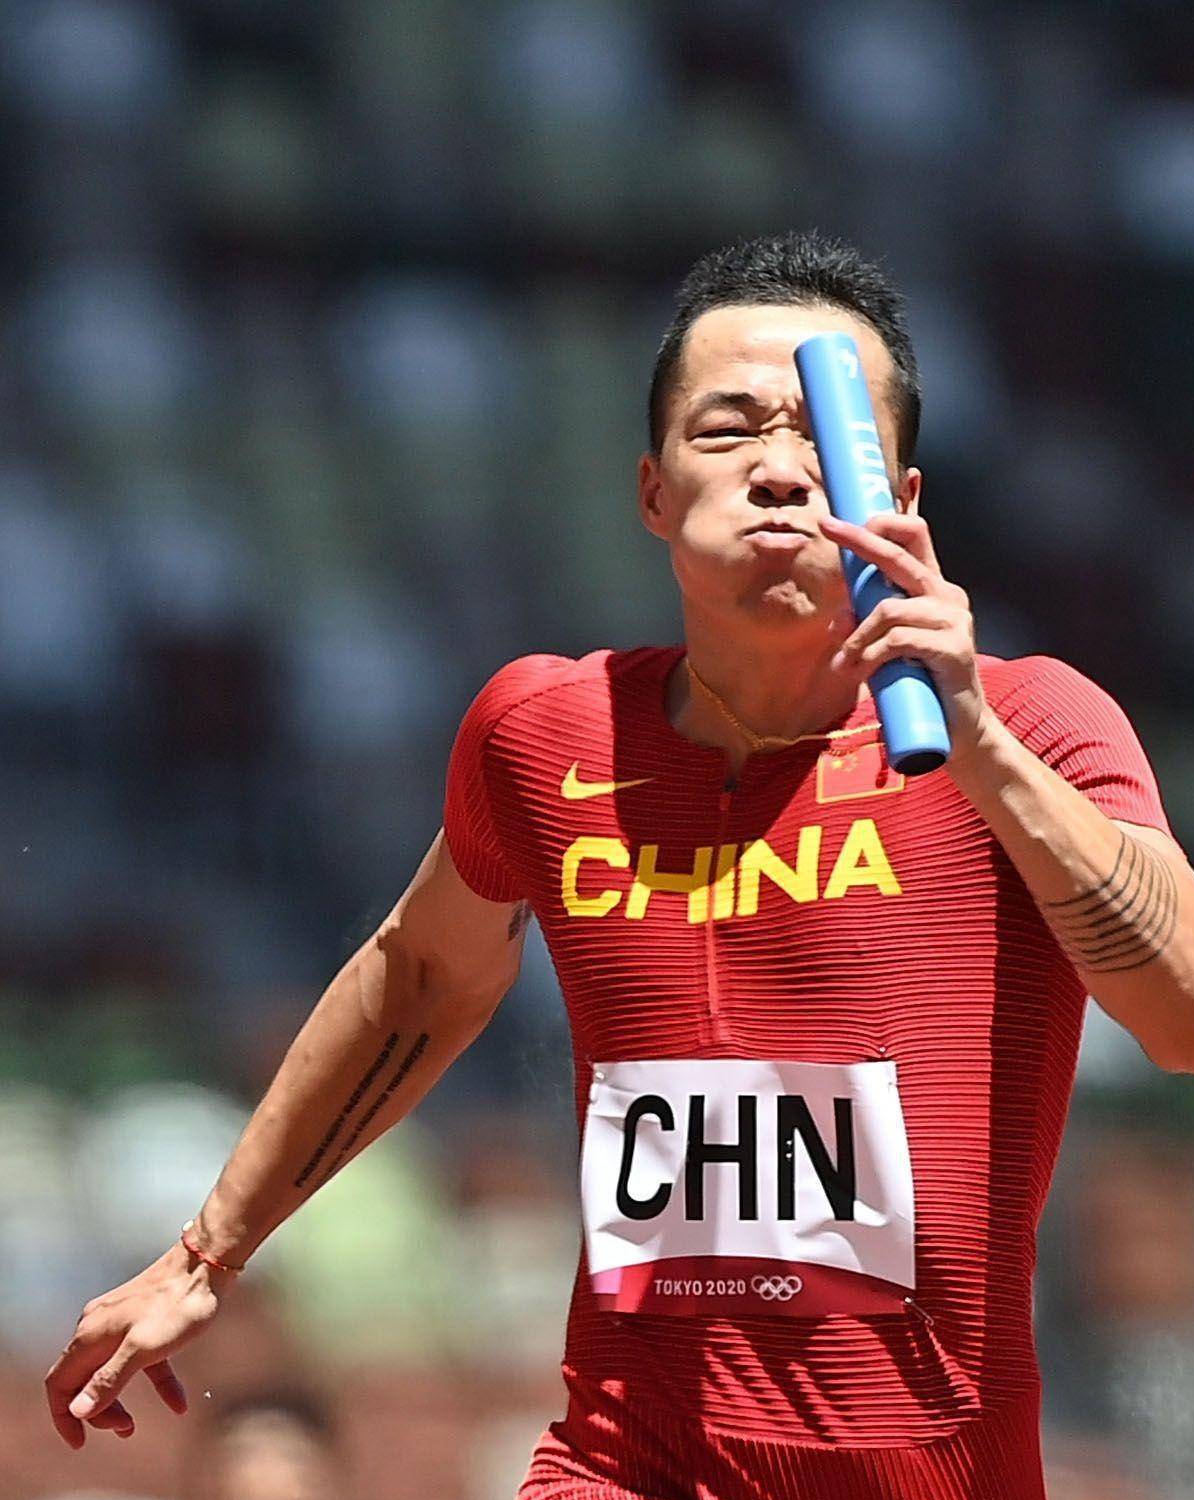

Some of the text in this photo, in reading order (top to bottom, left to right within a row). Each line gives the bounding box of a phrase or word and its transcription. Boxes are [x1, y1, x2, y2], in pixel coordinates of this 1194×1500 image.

[561, 819, 903, 924] CHINA
[615, 1094, 858, 1222] CHN
[654, 1279, 747, 1296] TOKYO 2020
